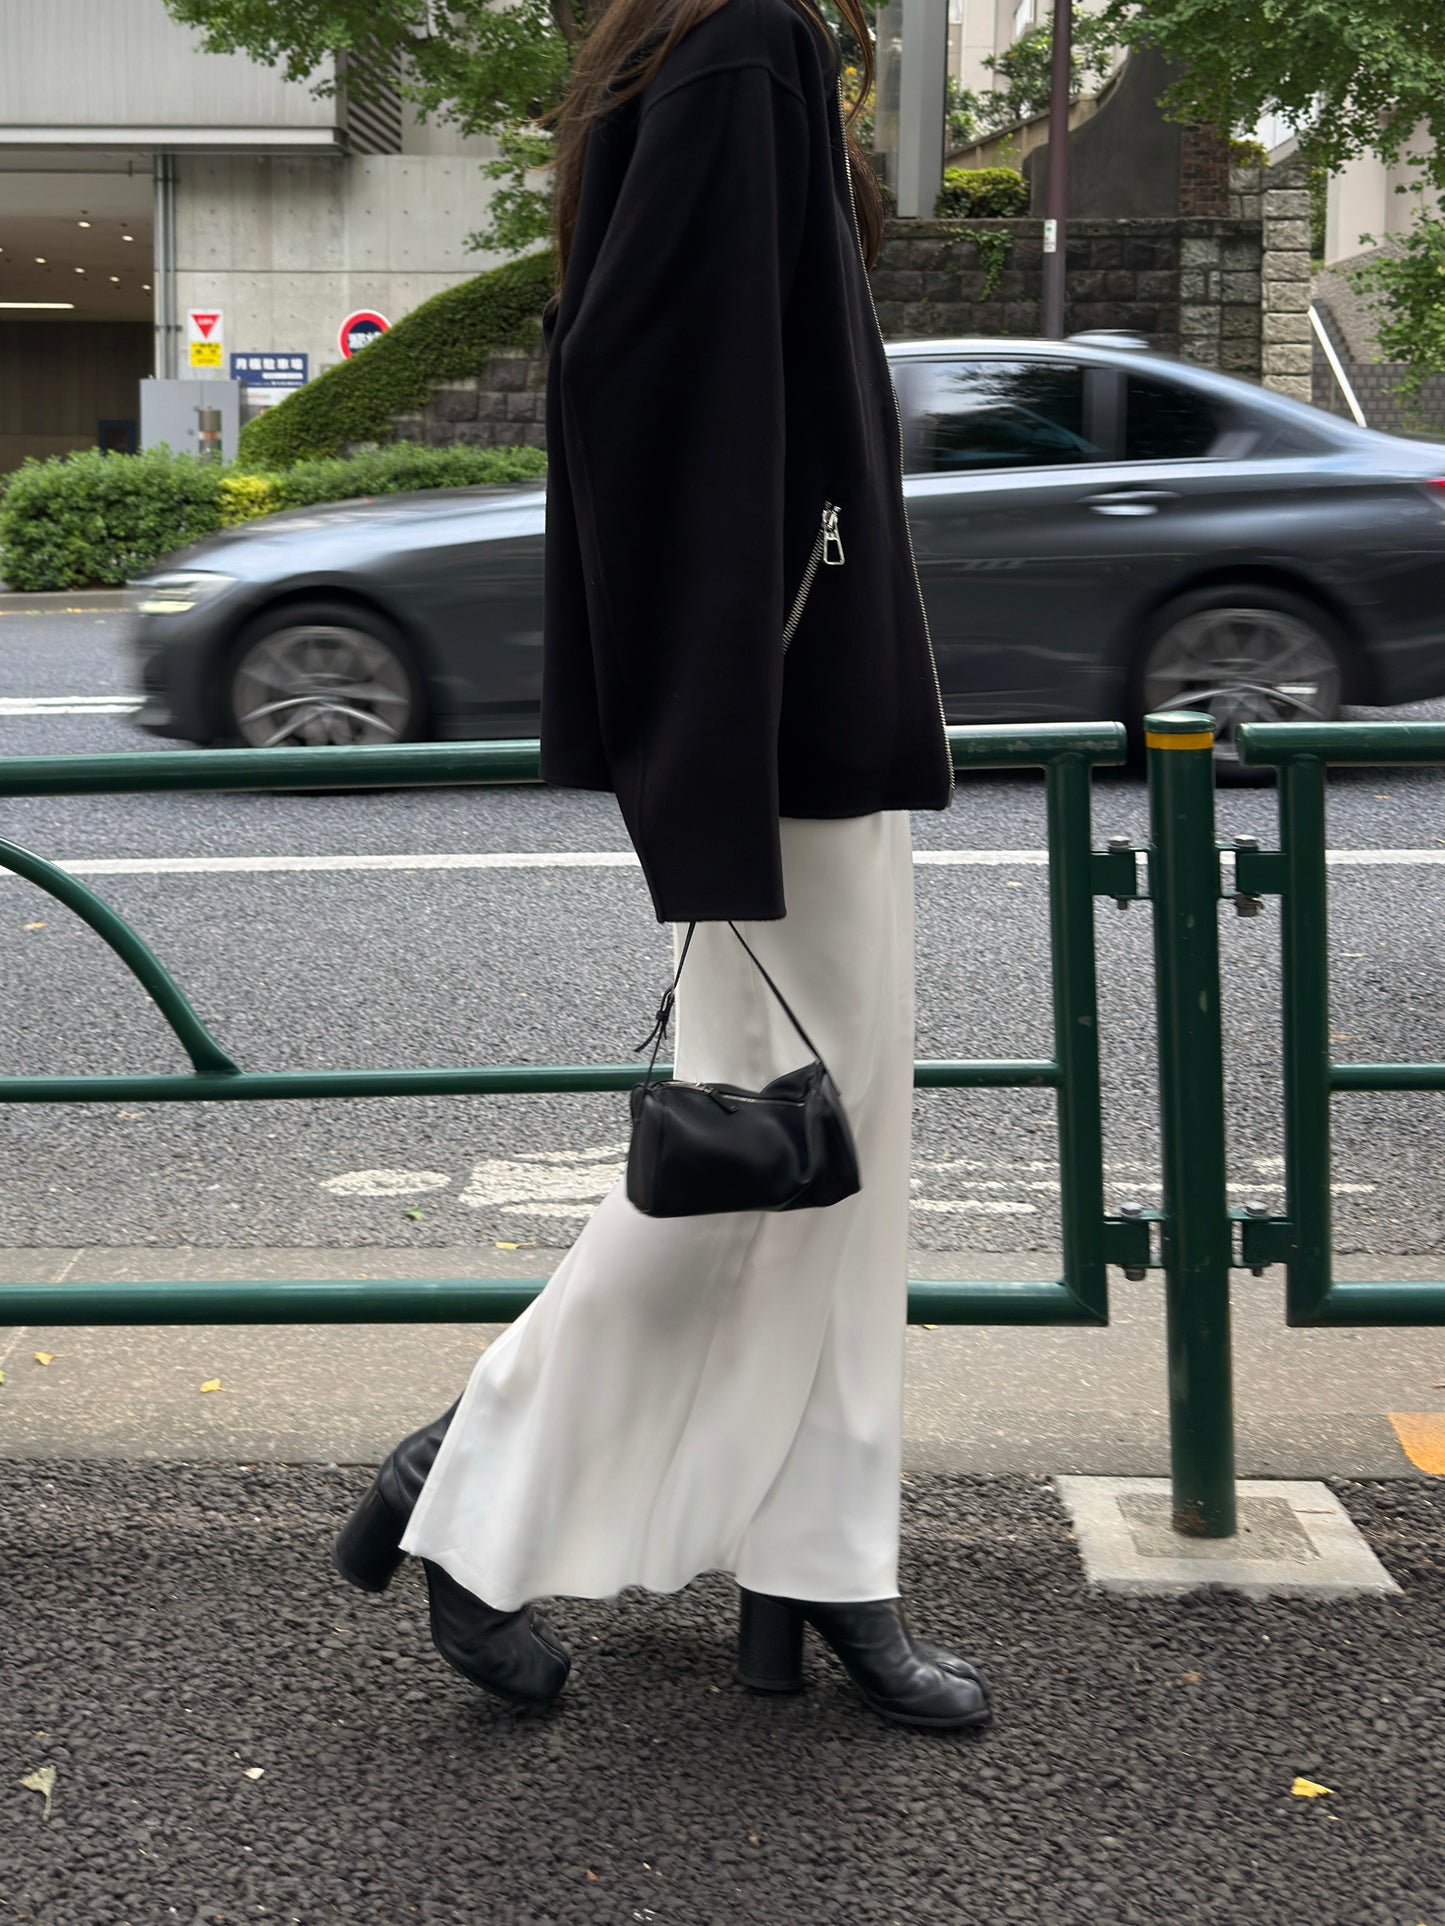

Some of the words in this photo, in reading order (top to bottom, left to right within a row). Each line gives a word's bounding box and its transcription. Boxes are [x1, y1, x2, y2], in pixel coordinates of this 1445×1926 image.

[235, 358, 303, 370] 月極駐車場
